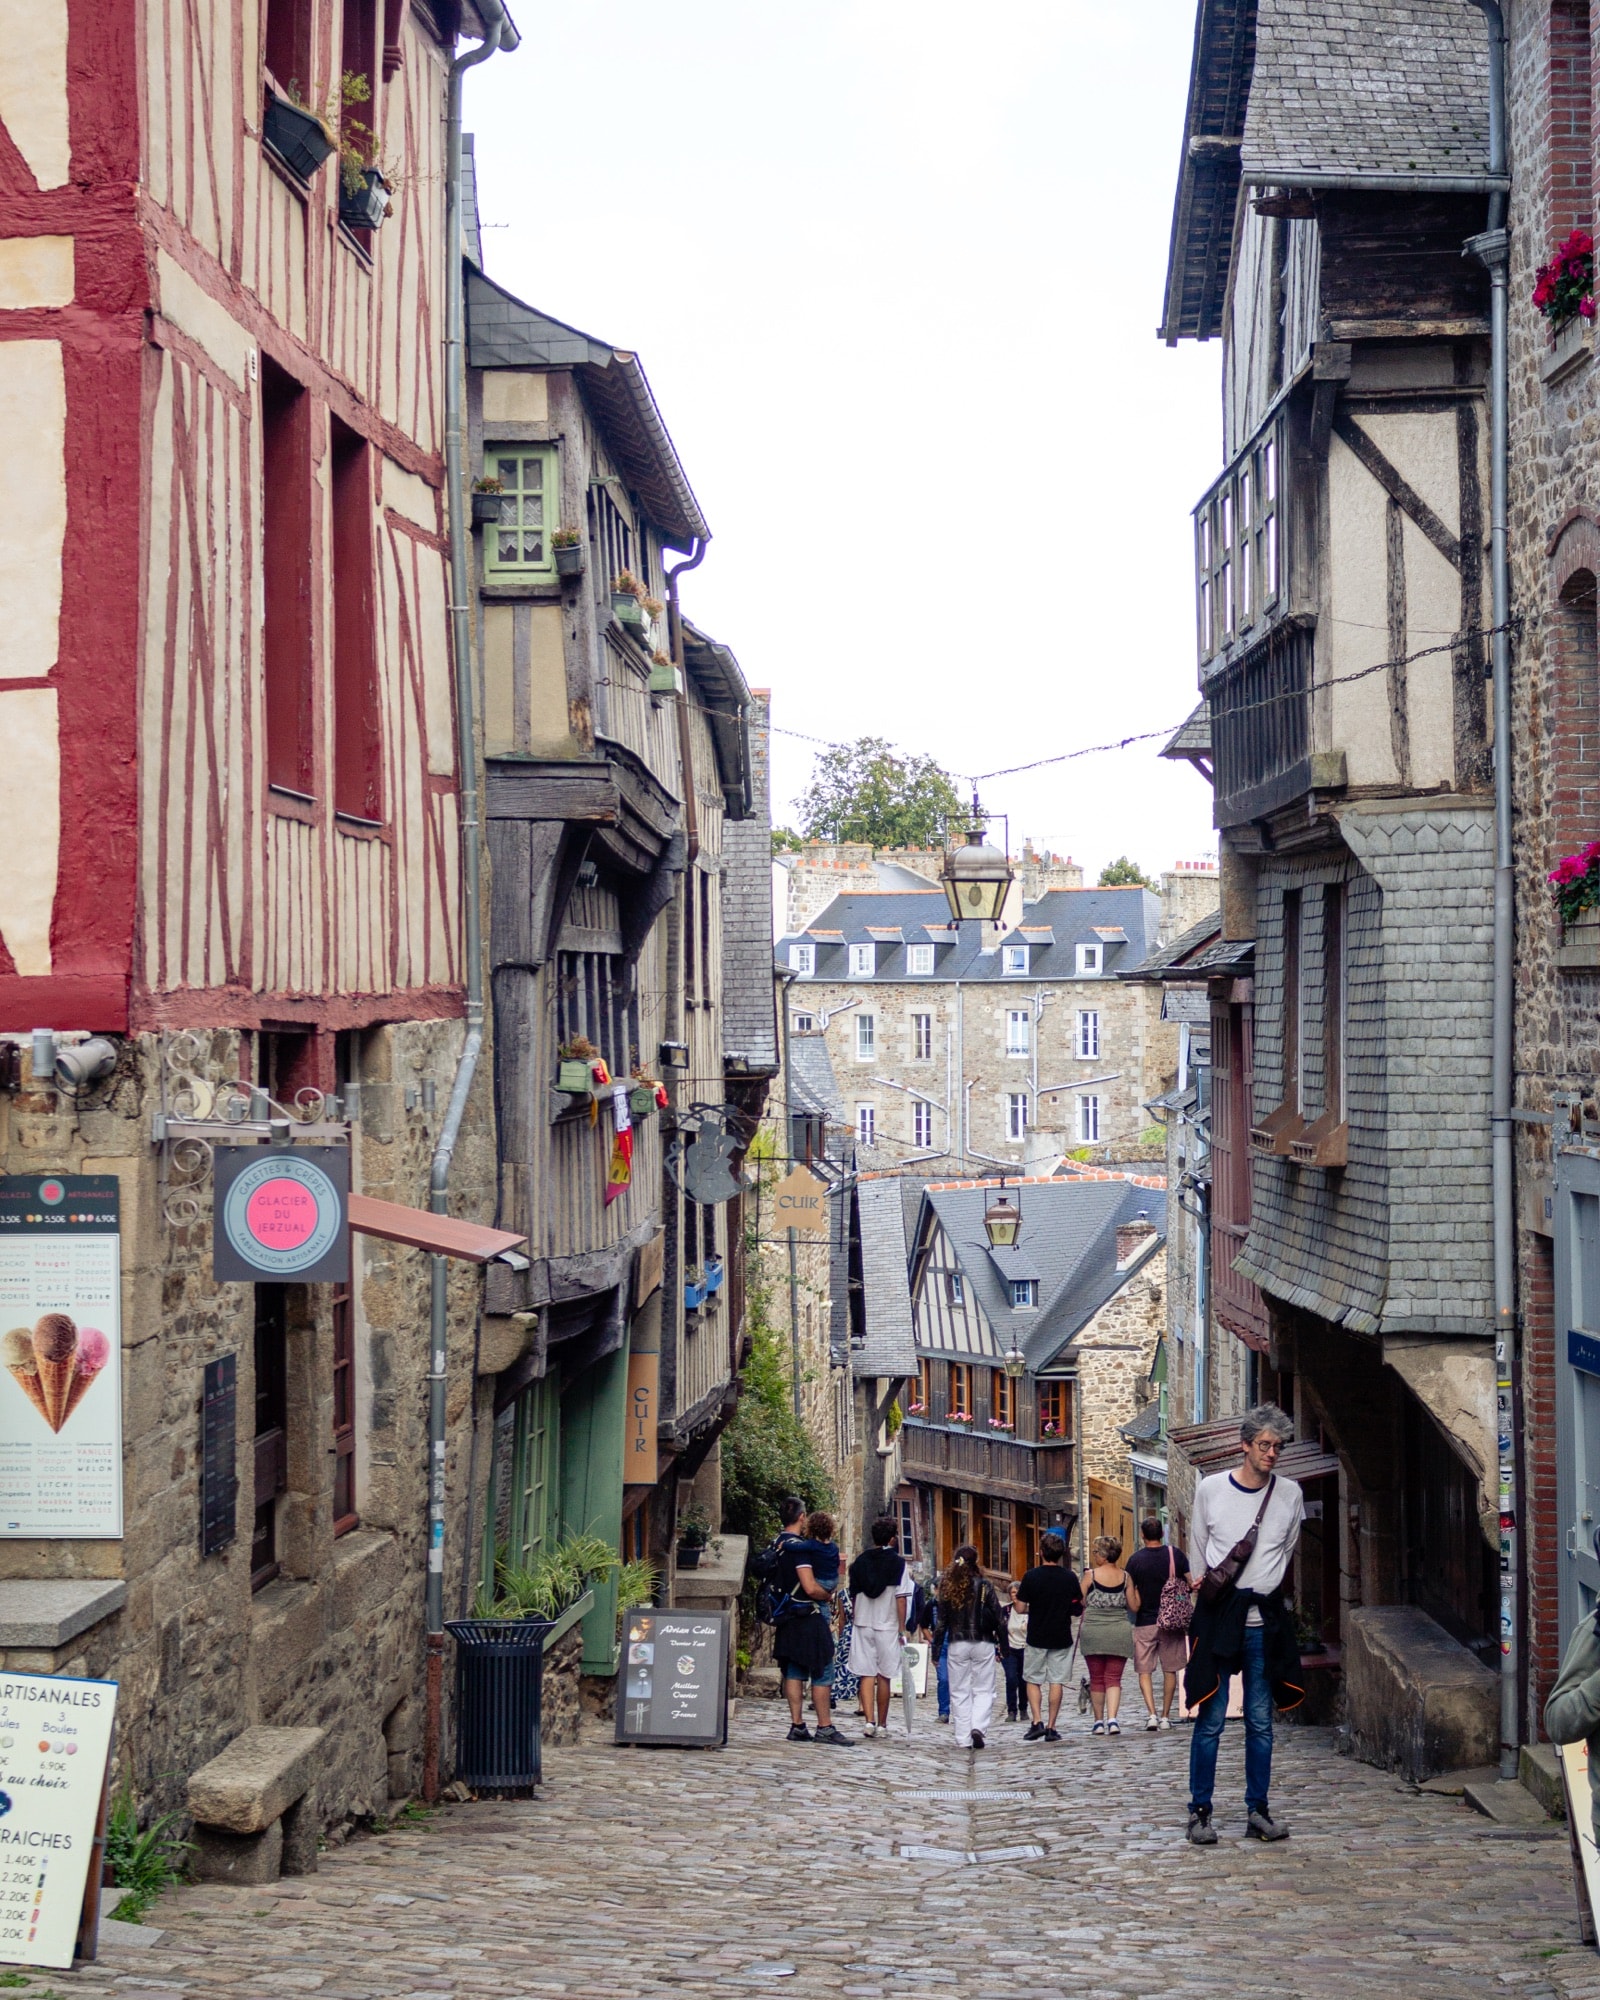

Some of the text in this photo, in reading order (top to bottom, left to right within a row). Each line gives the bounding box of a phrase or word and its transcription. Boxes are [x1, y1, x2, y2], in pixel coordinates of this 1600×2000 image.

[240, 1165, 281, 1195] GALETTES
[284, 1165, 292, 1173] &
[258, 1196, 308, 1206] GLACIER
[44, 1215, 66, 1223] 5.50€
[95, 1215, 117, 1223] 6.90€
[274, 1209, 290, 1219] DU
[257, 1223, 306, 1233] JERZUAL
[238, 1232, 326, 1264] FABRICATION ARTISANALE
[660, 1625, 717, 1636] Adrian Colin
[1, 1706, 9, 1717] 2
[58, 1712, 66, 1722] 3
[670, 1710, 697, 1719] France
[42, 1721, 78, 1735] Boules
[40, 1761, 67, 1772] 6.90€
[7, 1774, 27, 1785] au
[29, 1773, 71, 1789] choix
[4, 1854, 37, 1867] 1.40€
[1, 1872, 33, 1885] 2.20€
